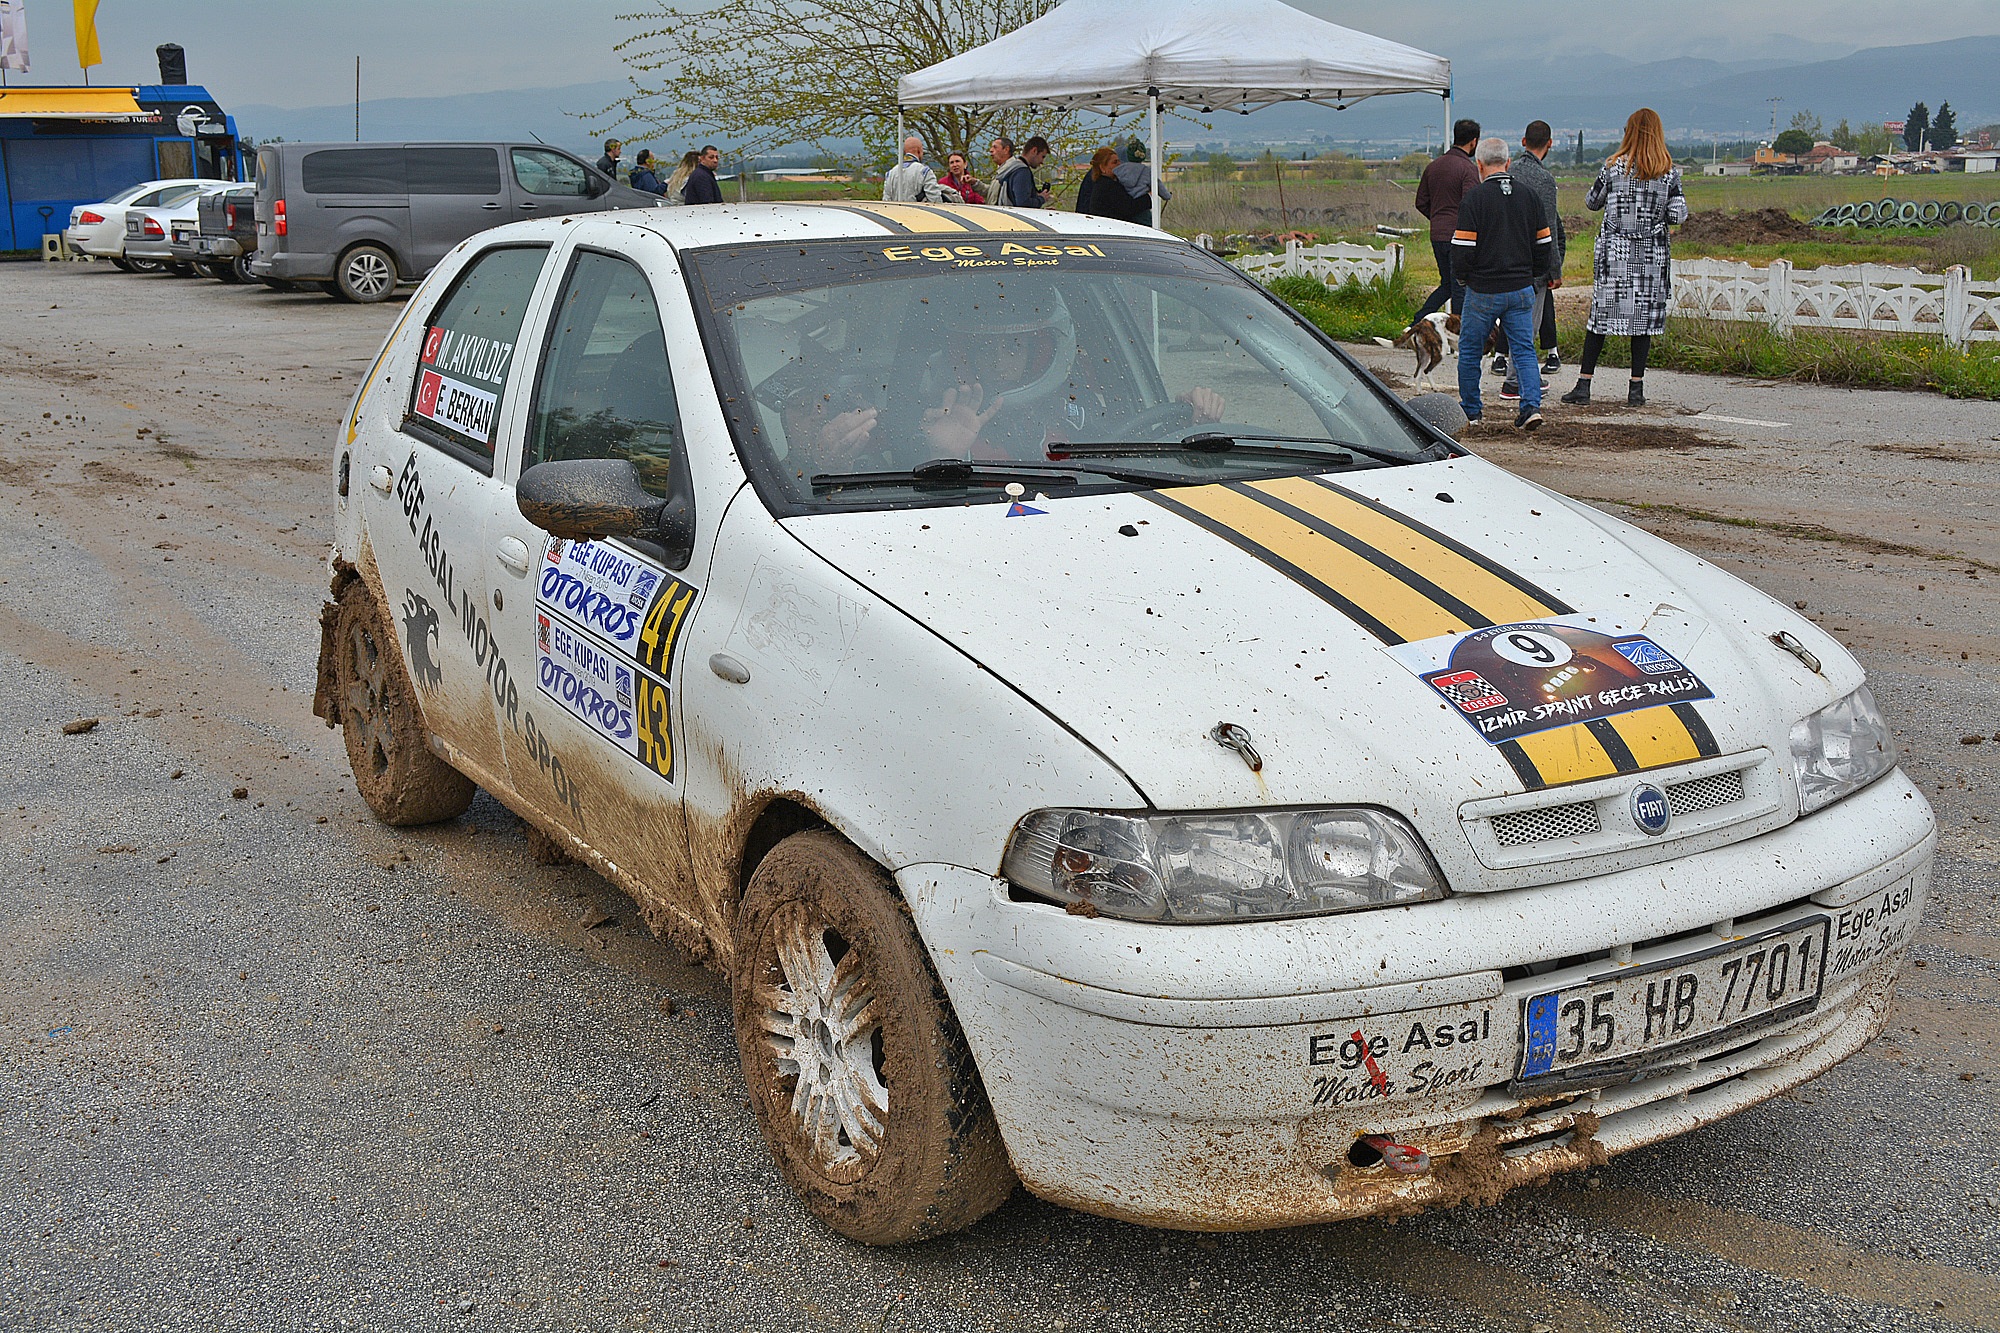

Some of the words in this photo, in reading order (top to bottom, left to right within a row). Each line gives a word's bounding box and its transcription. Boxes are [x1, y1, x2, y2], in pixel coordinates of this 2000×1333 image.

[882, 245, 983, 262] Ege
[1001, 243, 1106, 258] Asal
[955, 259, 1007, 268] Motor
[1014, 257, 1059, 267] Sport
[435, 329, 455, 371] M.
[450, 334, 513, 385] AKYILDIZ
[435, 384, 446, 417] E.
[446, 388, 494, 435] BERKAN
[569, 543, 595, 566] EGE
[590, 548, 635, 587] KUPASI
[397, 451, 425, 537] EGE
[419, 513, 457, 617] ASAL
[463, 588, 519, 736] MOTOR
[542, 567, 640, 640] OTOKROS
[642, 581, 693, 675] 41
[1507, 634, 1555, 663] 9
[556, 627, 572, 659] EGE
[575, 639, 609, 684] KUPASI
[540, 656, 632, 738] OTOKROS
[1462, 694, 1504, 711] TOSFED
[1477, 707, 1533, 734] İZMİR
[1534, 694, 1595, 721] SPRINT
[1599, 685, 1646, 706] GECE
[638, 677, 671, 776] 43
[1637, 798, 1666, 820] FIAT
[1837, 907, 1875, 940] Ege
[1878, 877, 1914, 922] Asal
[1832, 946, 1873, 976] Motor
[1874, 922, 1907, 958] Sport
[1558, 991, 1615, 1062] 35
[1644, 973, 1699, 1043] HB
[1717, 935, 1813, 1022] 7701
[1309, 1033, 1390, 1070] Ege
[1402, 1010, 1490, 1054] Asal
[1532, 1043, 1554, 1063] TR
[1313, 1075, 1397, 1107] Motor
[1406, 1058, 1483, 1098] Sport
